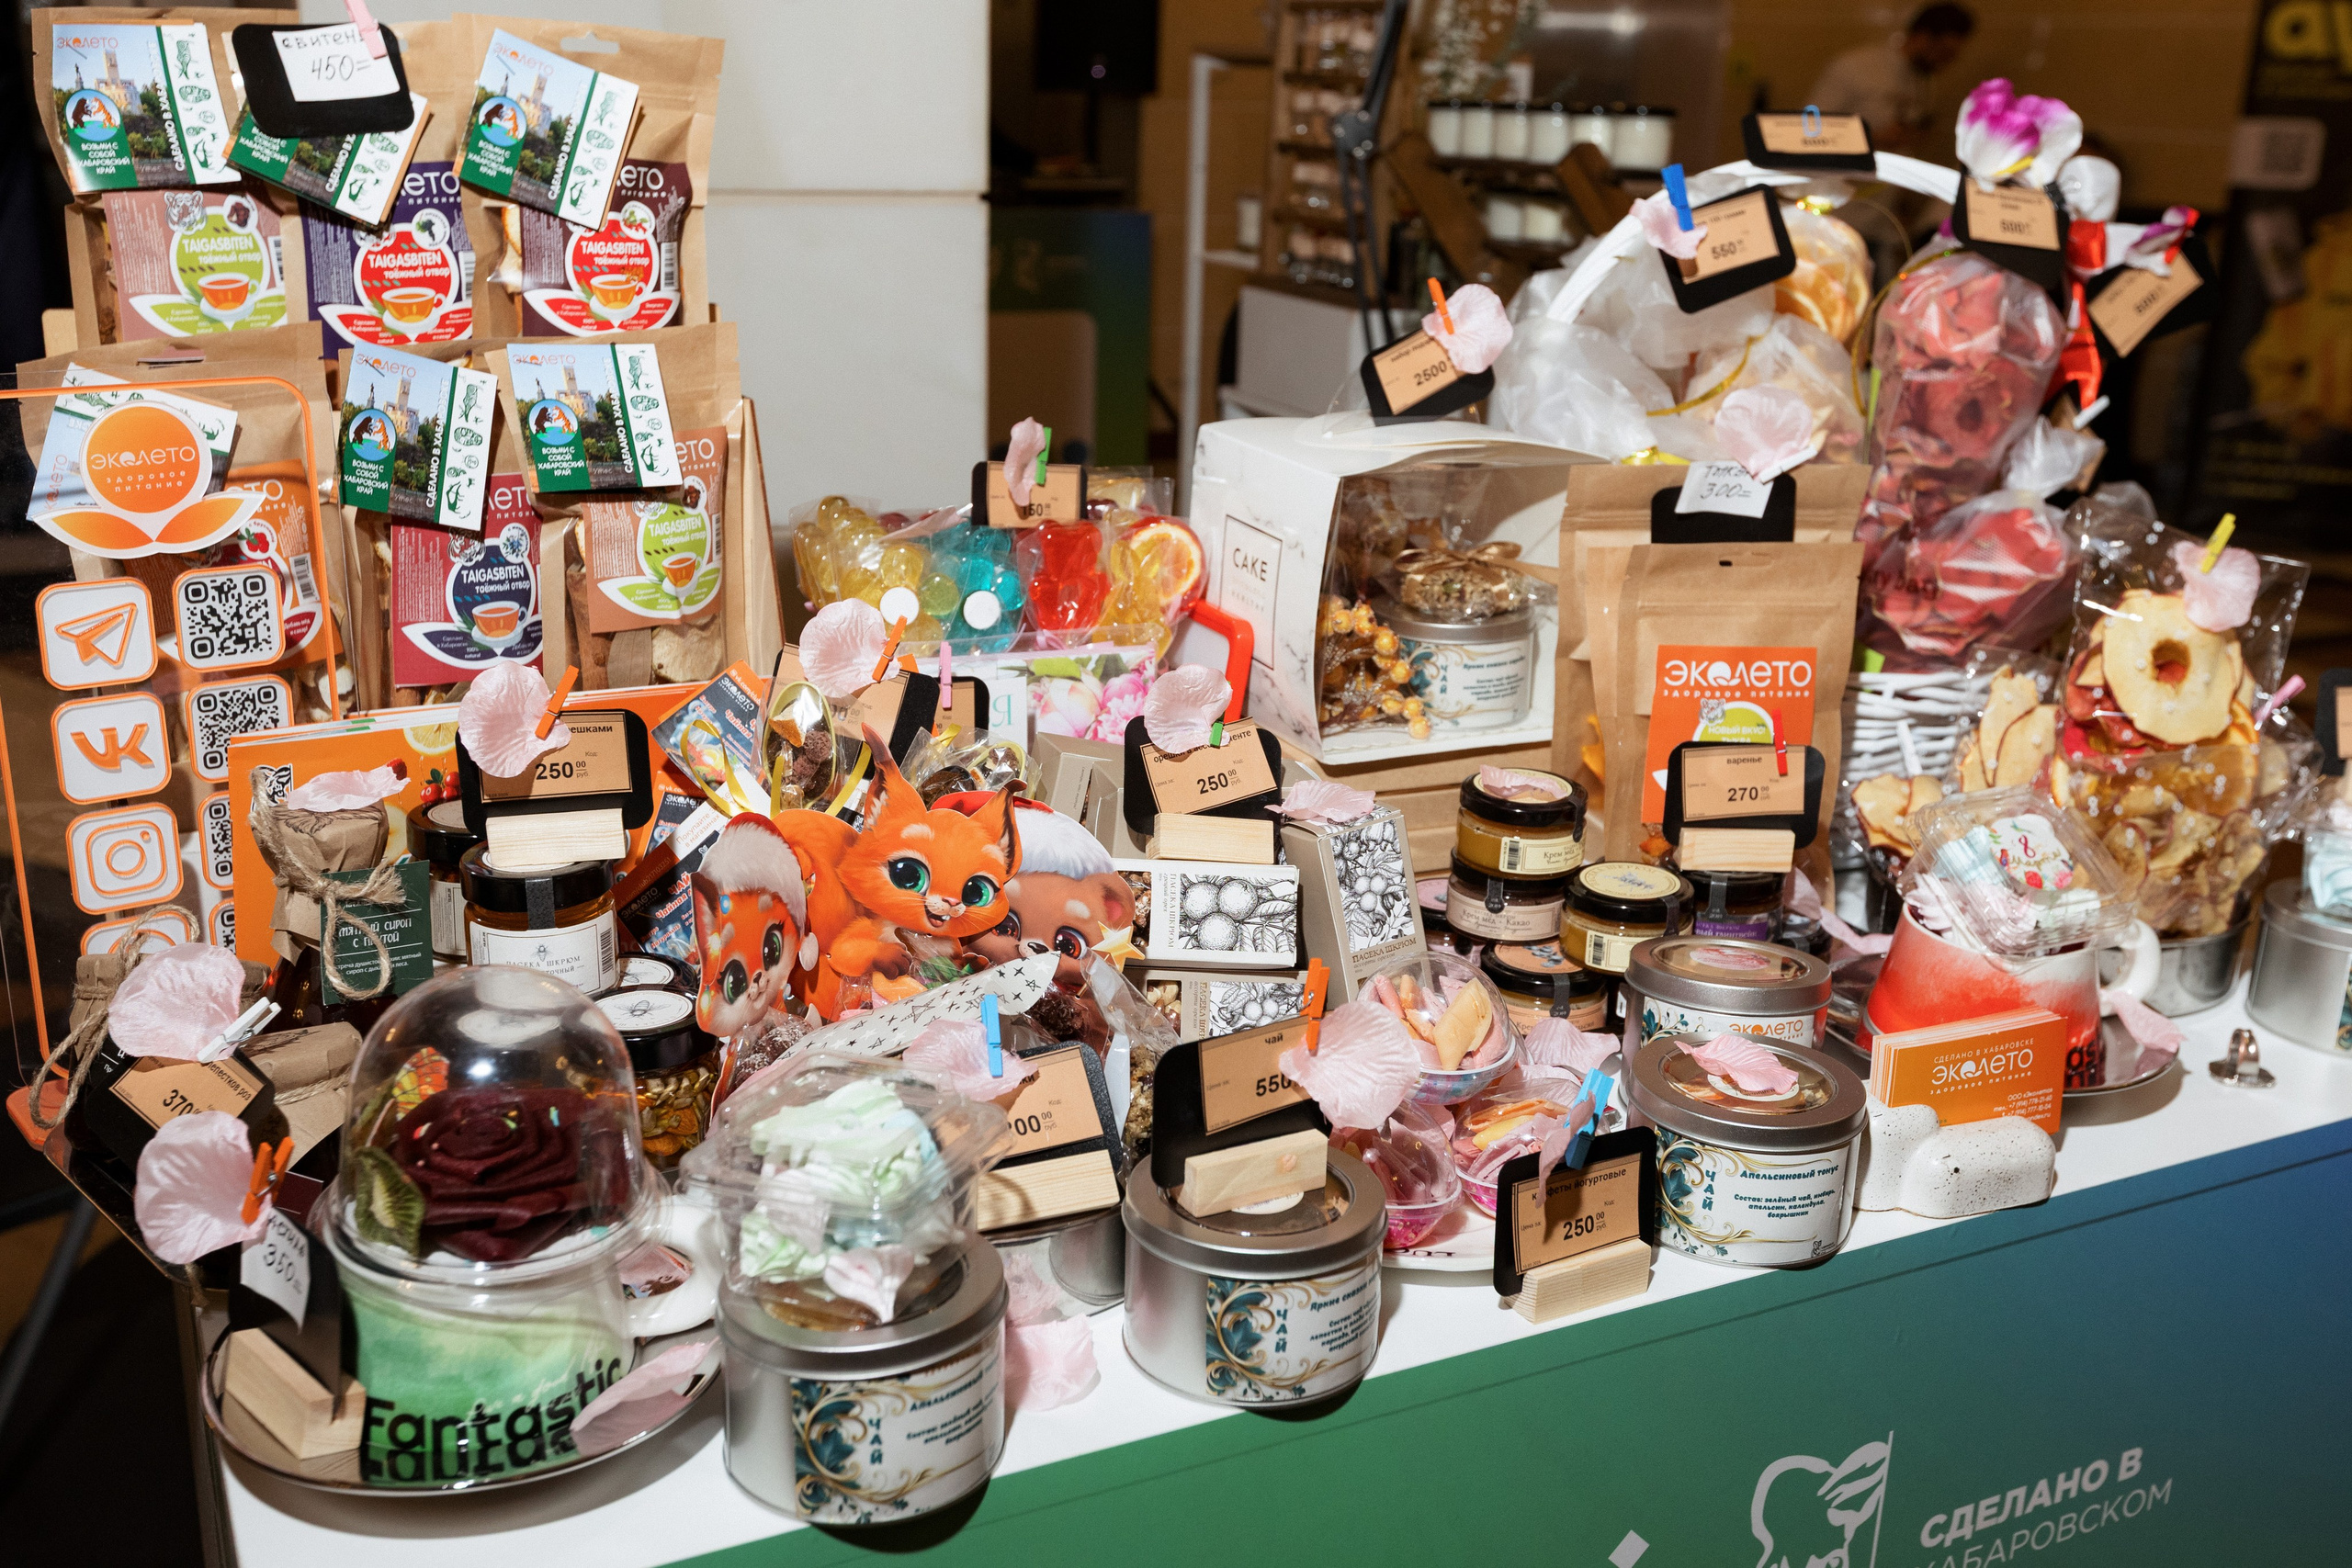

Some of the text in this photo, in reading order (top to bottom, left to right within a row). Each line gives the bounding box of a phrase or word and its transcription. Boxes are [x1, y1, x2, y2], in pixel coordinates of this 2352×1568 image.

[165, 120, 185, 172] СДЕЛАНО
[481, 149, 504, 164] СОБОЙ
[480, 164, 497, 177] КРАЙ
[548, 152, 568, 200] СДЕЛАНО
[182, 236, 254, 253] TAIGASBITEN
[580, 241, 645, 254] TAIGASBITEN
[368, 251, 442, 268] TAIGASBITEN
[1414, 360, 1447, 386] 2500
[542, 446, 570, 455] ВОЗЬМИ
[616, 428, 634, 473] СДЕЛАНО
[352, 459, 384, 473] ВОЗЬМИ С
[537, 460, 584, 469] ХАБАРОВСКИЙ
[106, 469, 187, 484] здоровое
[356, 468, 379, 479] СОБОЙ
[426, 457, 440, 508] СДЕЛАНО
[433, 447, 440, 456] В
[114, 479, 183, 493] питание
[344, 474, 389, 491] ХАБАРОВСКИЙ
[356, 486, 373, 495] КРАЙ
[648, 515, 702, 537] TAIGASBITEN
[1233, 547, 1268, 582] CAKE
[461, 564, 525, 584] TAIGASBITEN
[475, 581, 510, 593] таёжный
[1663, 690, 1741, 698] здоровое
[1708, 726, 1765, 735] НОВЫЙ ВКУС!
[1726, 757, 1762, 765] варенье
[535, 761, 573, 780] 250
[1196, 773, 1228, 795] 250
[1727, 786, 1758, 802] 270
[676, 812, 711, 844] Покупайте
[689, 814, 720, 844] магазинах
[2018, 834, 2036, 858] 8
[656, 894, 687, 919] Чайная
[1168, 873, 1178, 949] ПАСЕКА ШКРЮМ
[384, 919, 412, 931] СИРОП
[353, 939, 359, 948] С
[1352, 937, 1417, 963] ПАСЕКА ШКРЮМ
[547, 956, 580, 966] ШКРЮМ
[1199, 982, 1207, 1017] ПАСЕКА
[1265, 1033, 1283, 1044] чай
[1934, 1050, 1973, 1064] СДЕЛАНО
[1984, 1037, 2034, 1055] ХАБАРОВСКЕ
[1930, 1071, 2032, 1096] здоровое питание
[237, 1088, 252, 1101] роз
[2007, 1093, 2022, 1101] ООО
[1041, 1111, 1053, 1121] 00
[1574, 1168, 1626, 1191] йогуртовые
[1740, 1164, 1839, 1180] Апельсиновый тонус
[1702, 1169, 1716, 1212] ЧАЙ
[1734, 1194, 1763, 1202] Состав:
[1768, 1210, 1808, 1220] боярышник
[1563, 1211, 1605, 1240] 250 00
[1310, 1297, 1340, 1313] Яркие
[1274, 1309, 1288, 1353] ЧАЙ
[365, 1358, 623, 1452] Fantastic
[869, 1418, 882, 1464] ЧАЙ
[1919, 1447, 2143, 1548] СДЕЛАНО В
